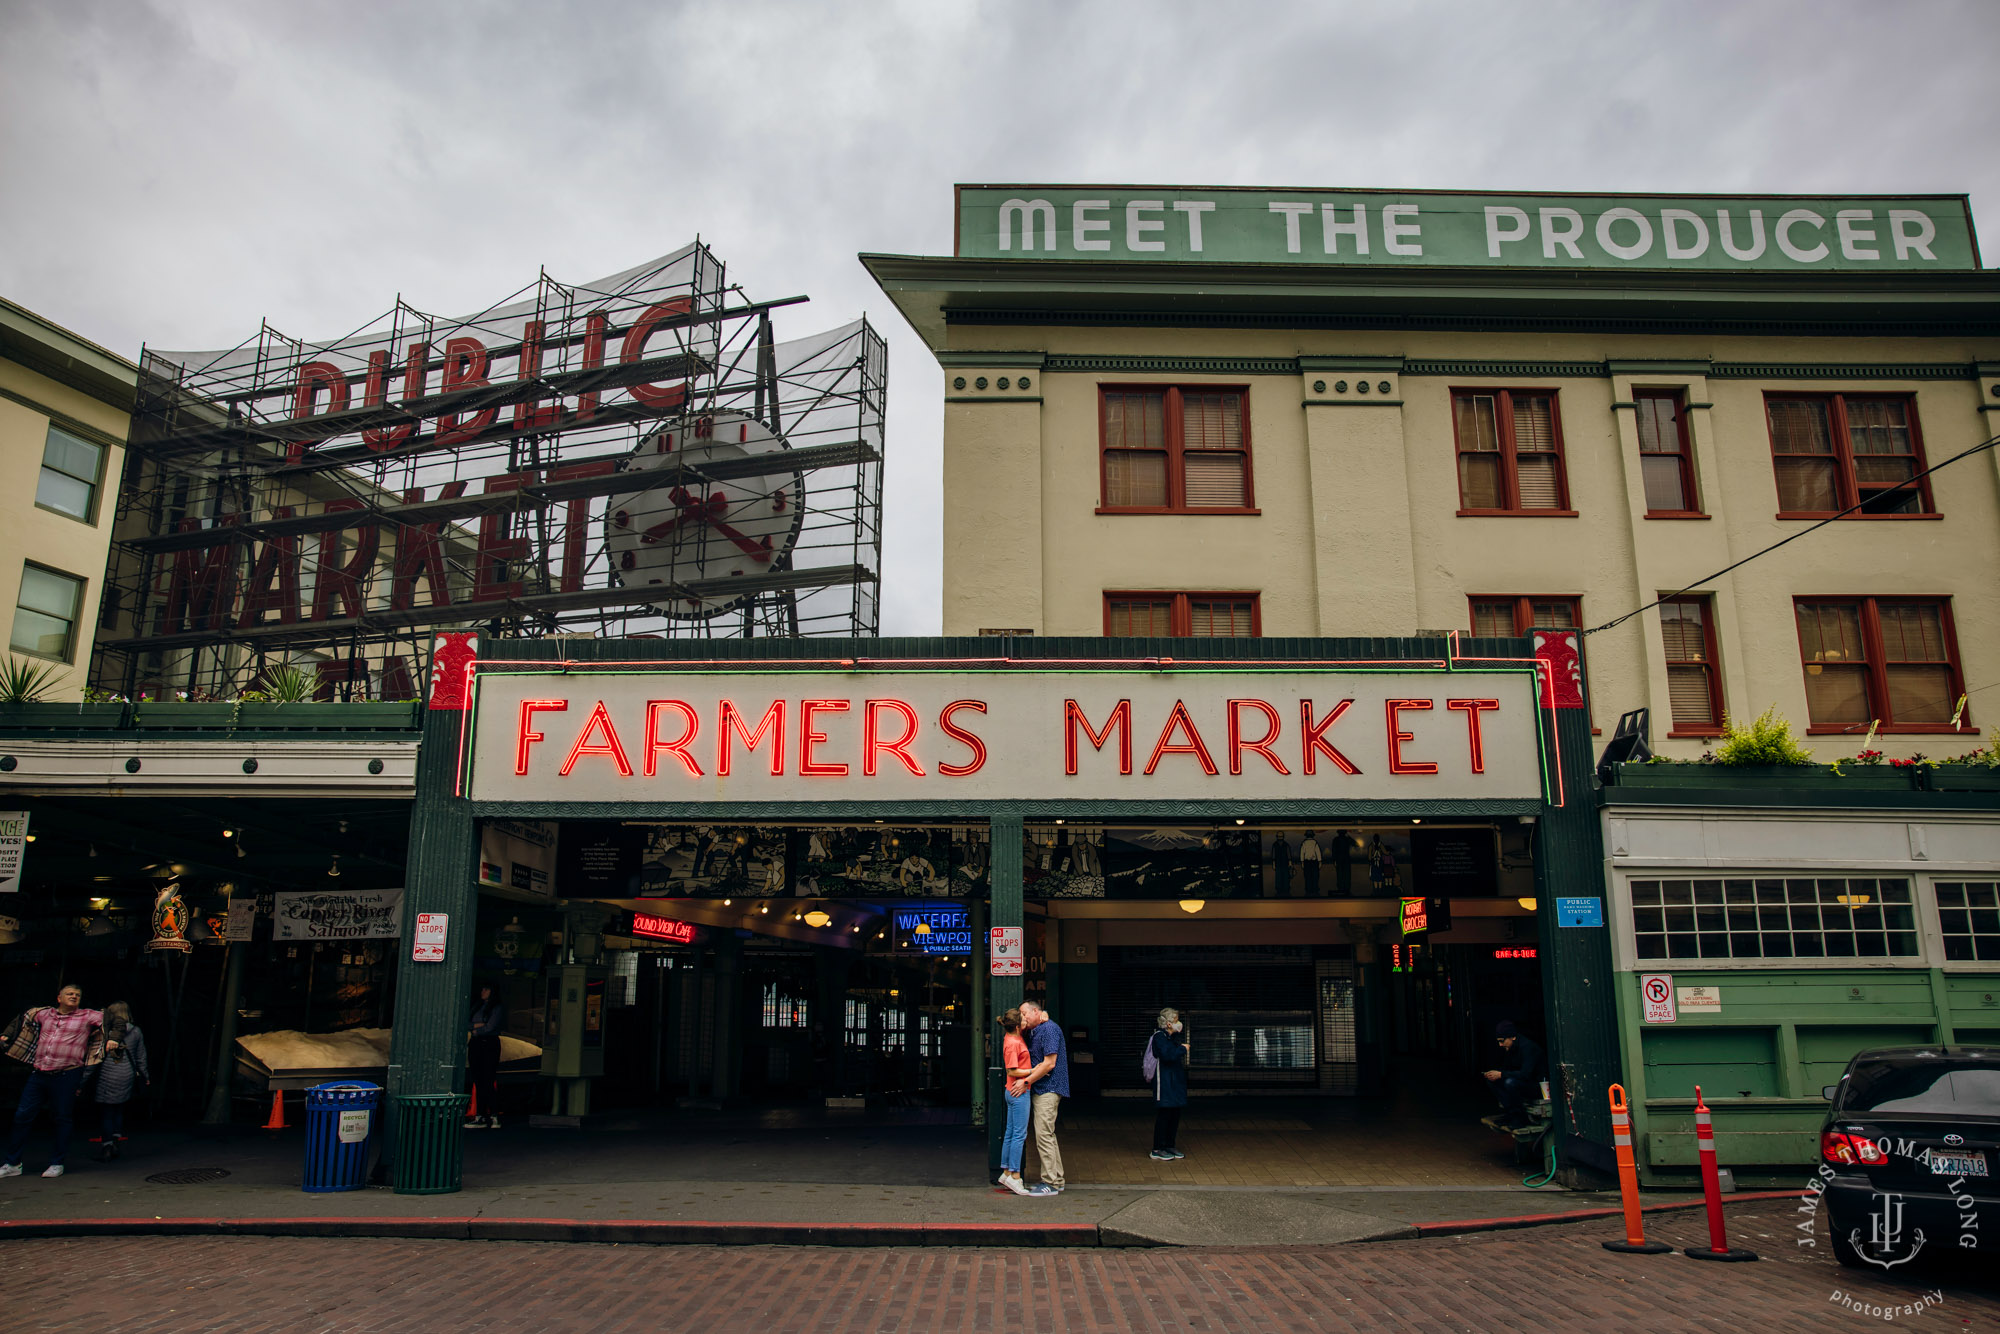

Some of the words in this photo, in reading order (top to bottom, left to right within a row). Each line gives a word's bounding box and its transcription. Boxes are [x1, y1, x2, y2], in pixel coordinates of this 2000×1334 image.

[999, 200, 1216, 252] MEET
[1268, 202, 1423, 257] THE
[1484, 206, 1937, 263] PRODUCER
[287, 294, 693, 464] PUBLIC
[162, 460, 620, 635] MARKET
[513, 698, 988, 780] FARMERS
[1063, 698, 1501, 776] MARKET
[360, 894, 383, 903] Fresh
[288, 904, 349, 924] Copper
[353, 903, 392, 919] River
[419, 915, 429, 923] NO
[308, 922, 368, 938] Salmon
[420, 925, 444, 934] STOPS
[995, 938, 1019, 947] STOPS
